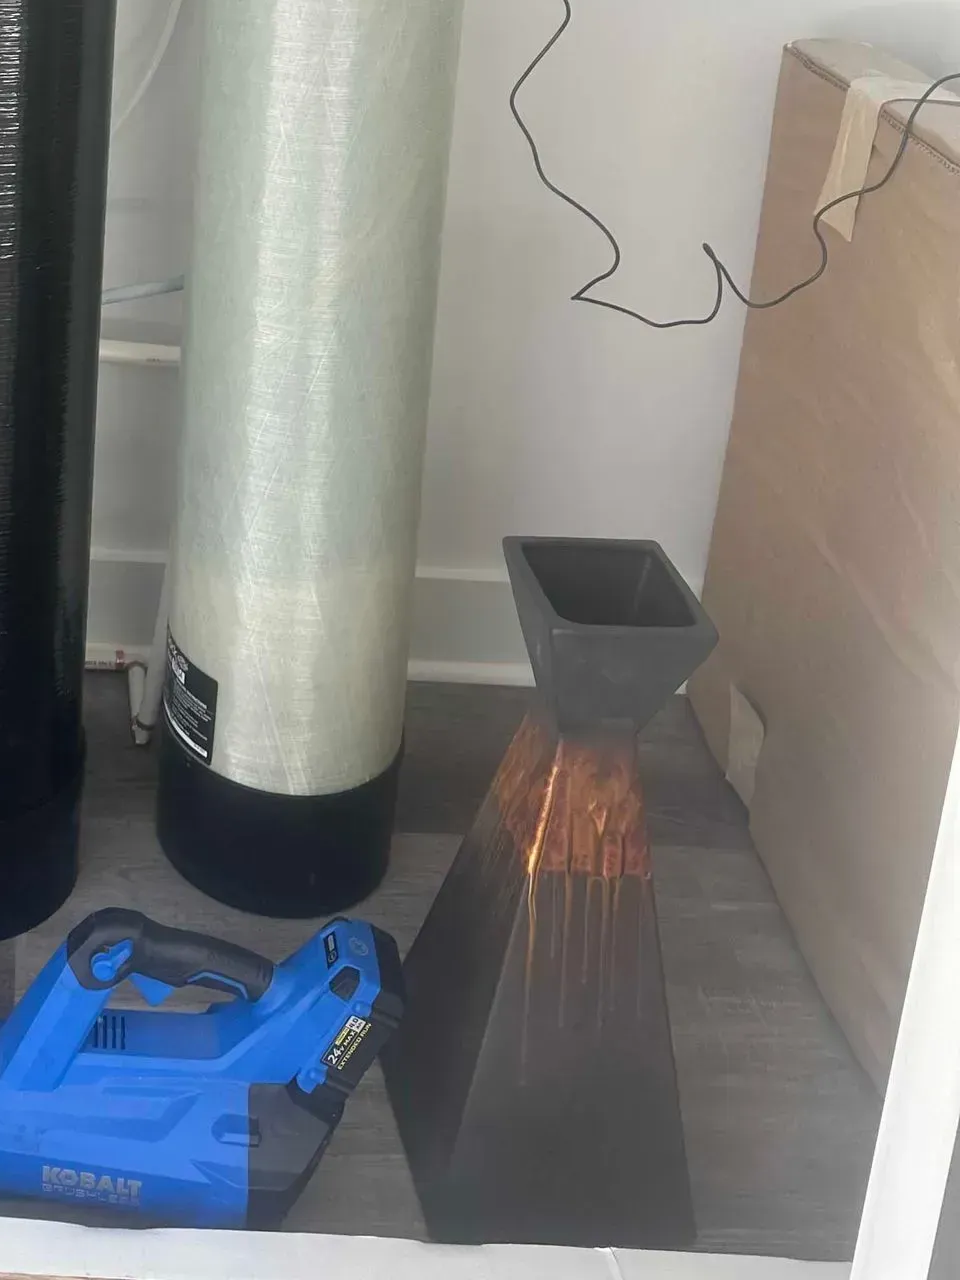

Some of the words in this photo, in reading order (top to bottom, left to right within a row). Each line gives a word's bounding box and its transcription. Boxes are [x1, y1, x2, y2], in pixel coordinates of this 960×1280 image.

[337, 1037, 362, 1070] EXTENDED
[360, 1023, 372, 1037] RUN
[42, 1165, 142, 1197] KOBALT
